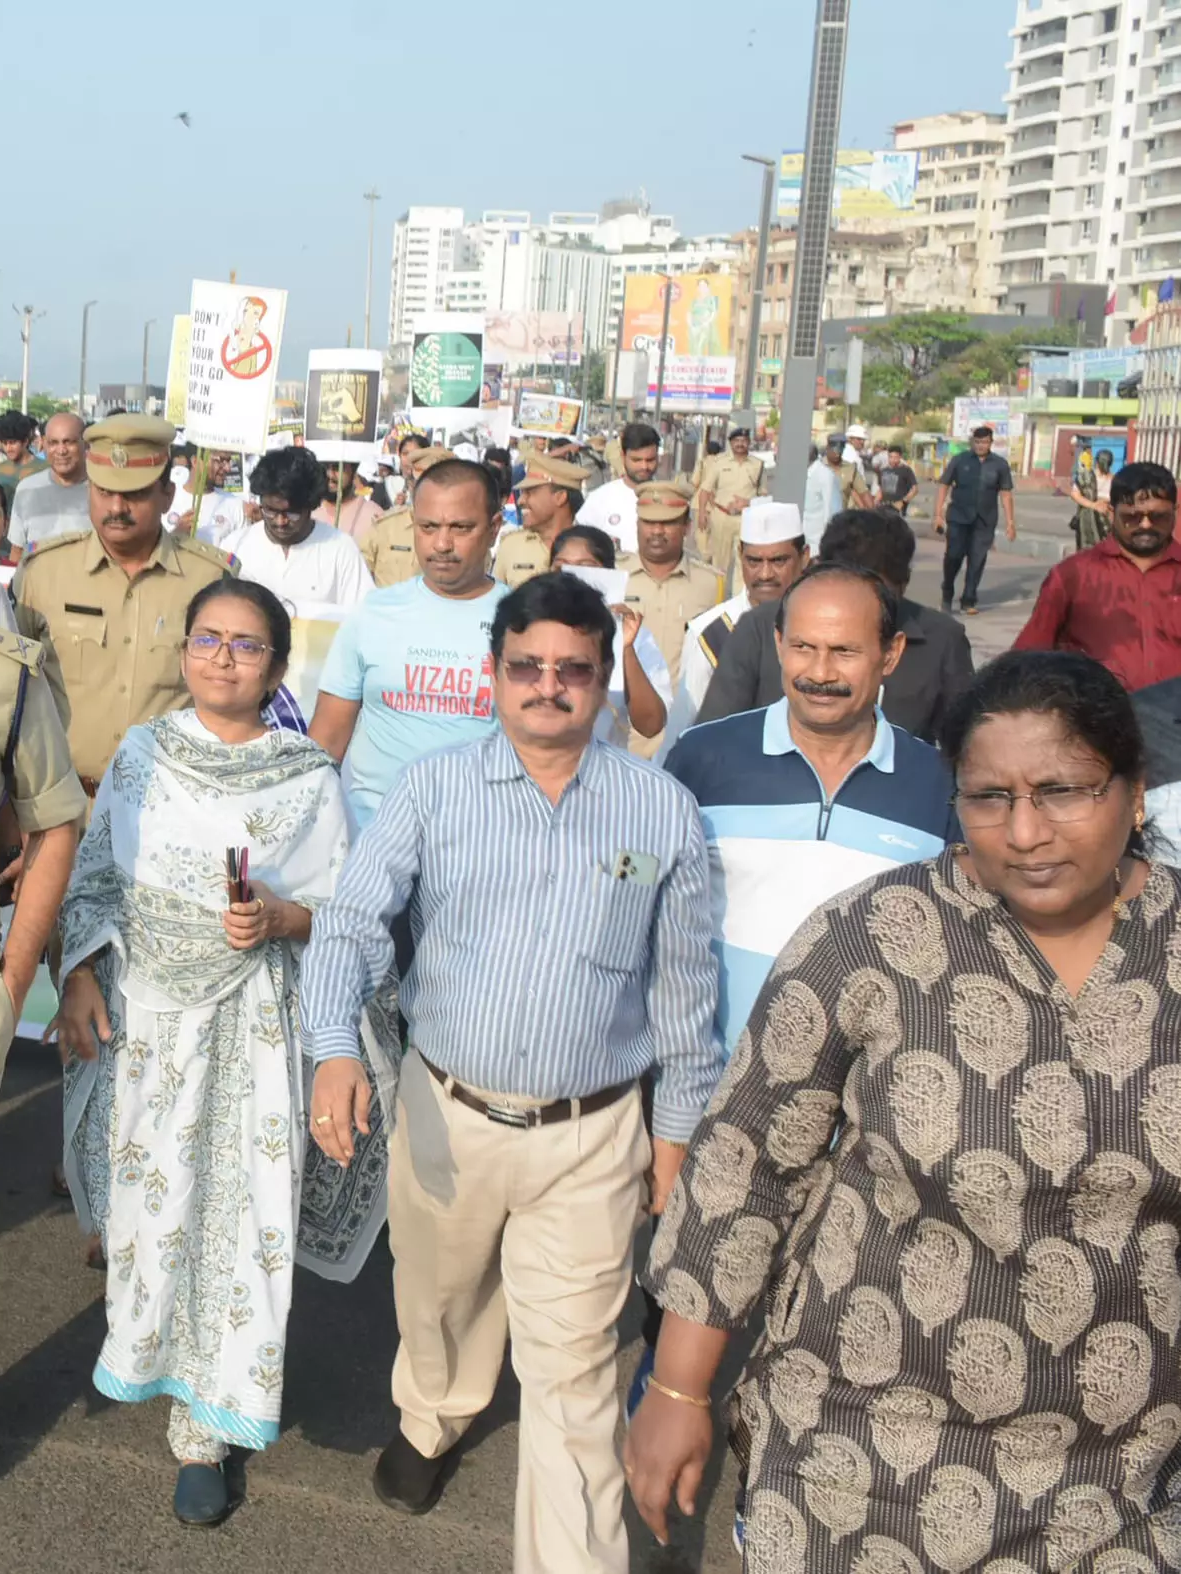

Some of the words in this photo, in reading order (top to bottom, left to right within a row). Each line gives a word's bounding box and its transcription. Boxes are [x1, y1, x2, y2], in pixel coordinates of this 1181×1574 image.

[191, 345, 214, 361] YOUR
[208, 367, 224, 381] GO
[407, 646, 460, 661] SANDHYA
[405, 663, 473, 695] VIZAG
[381, 689, 472, 716] MARATHON
